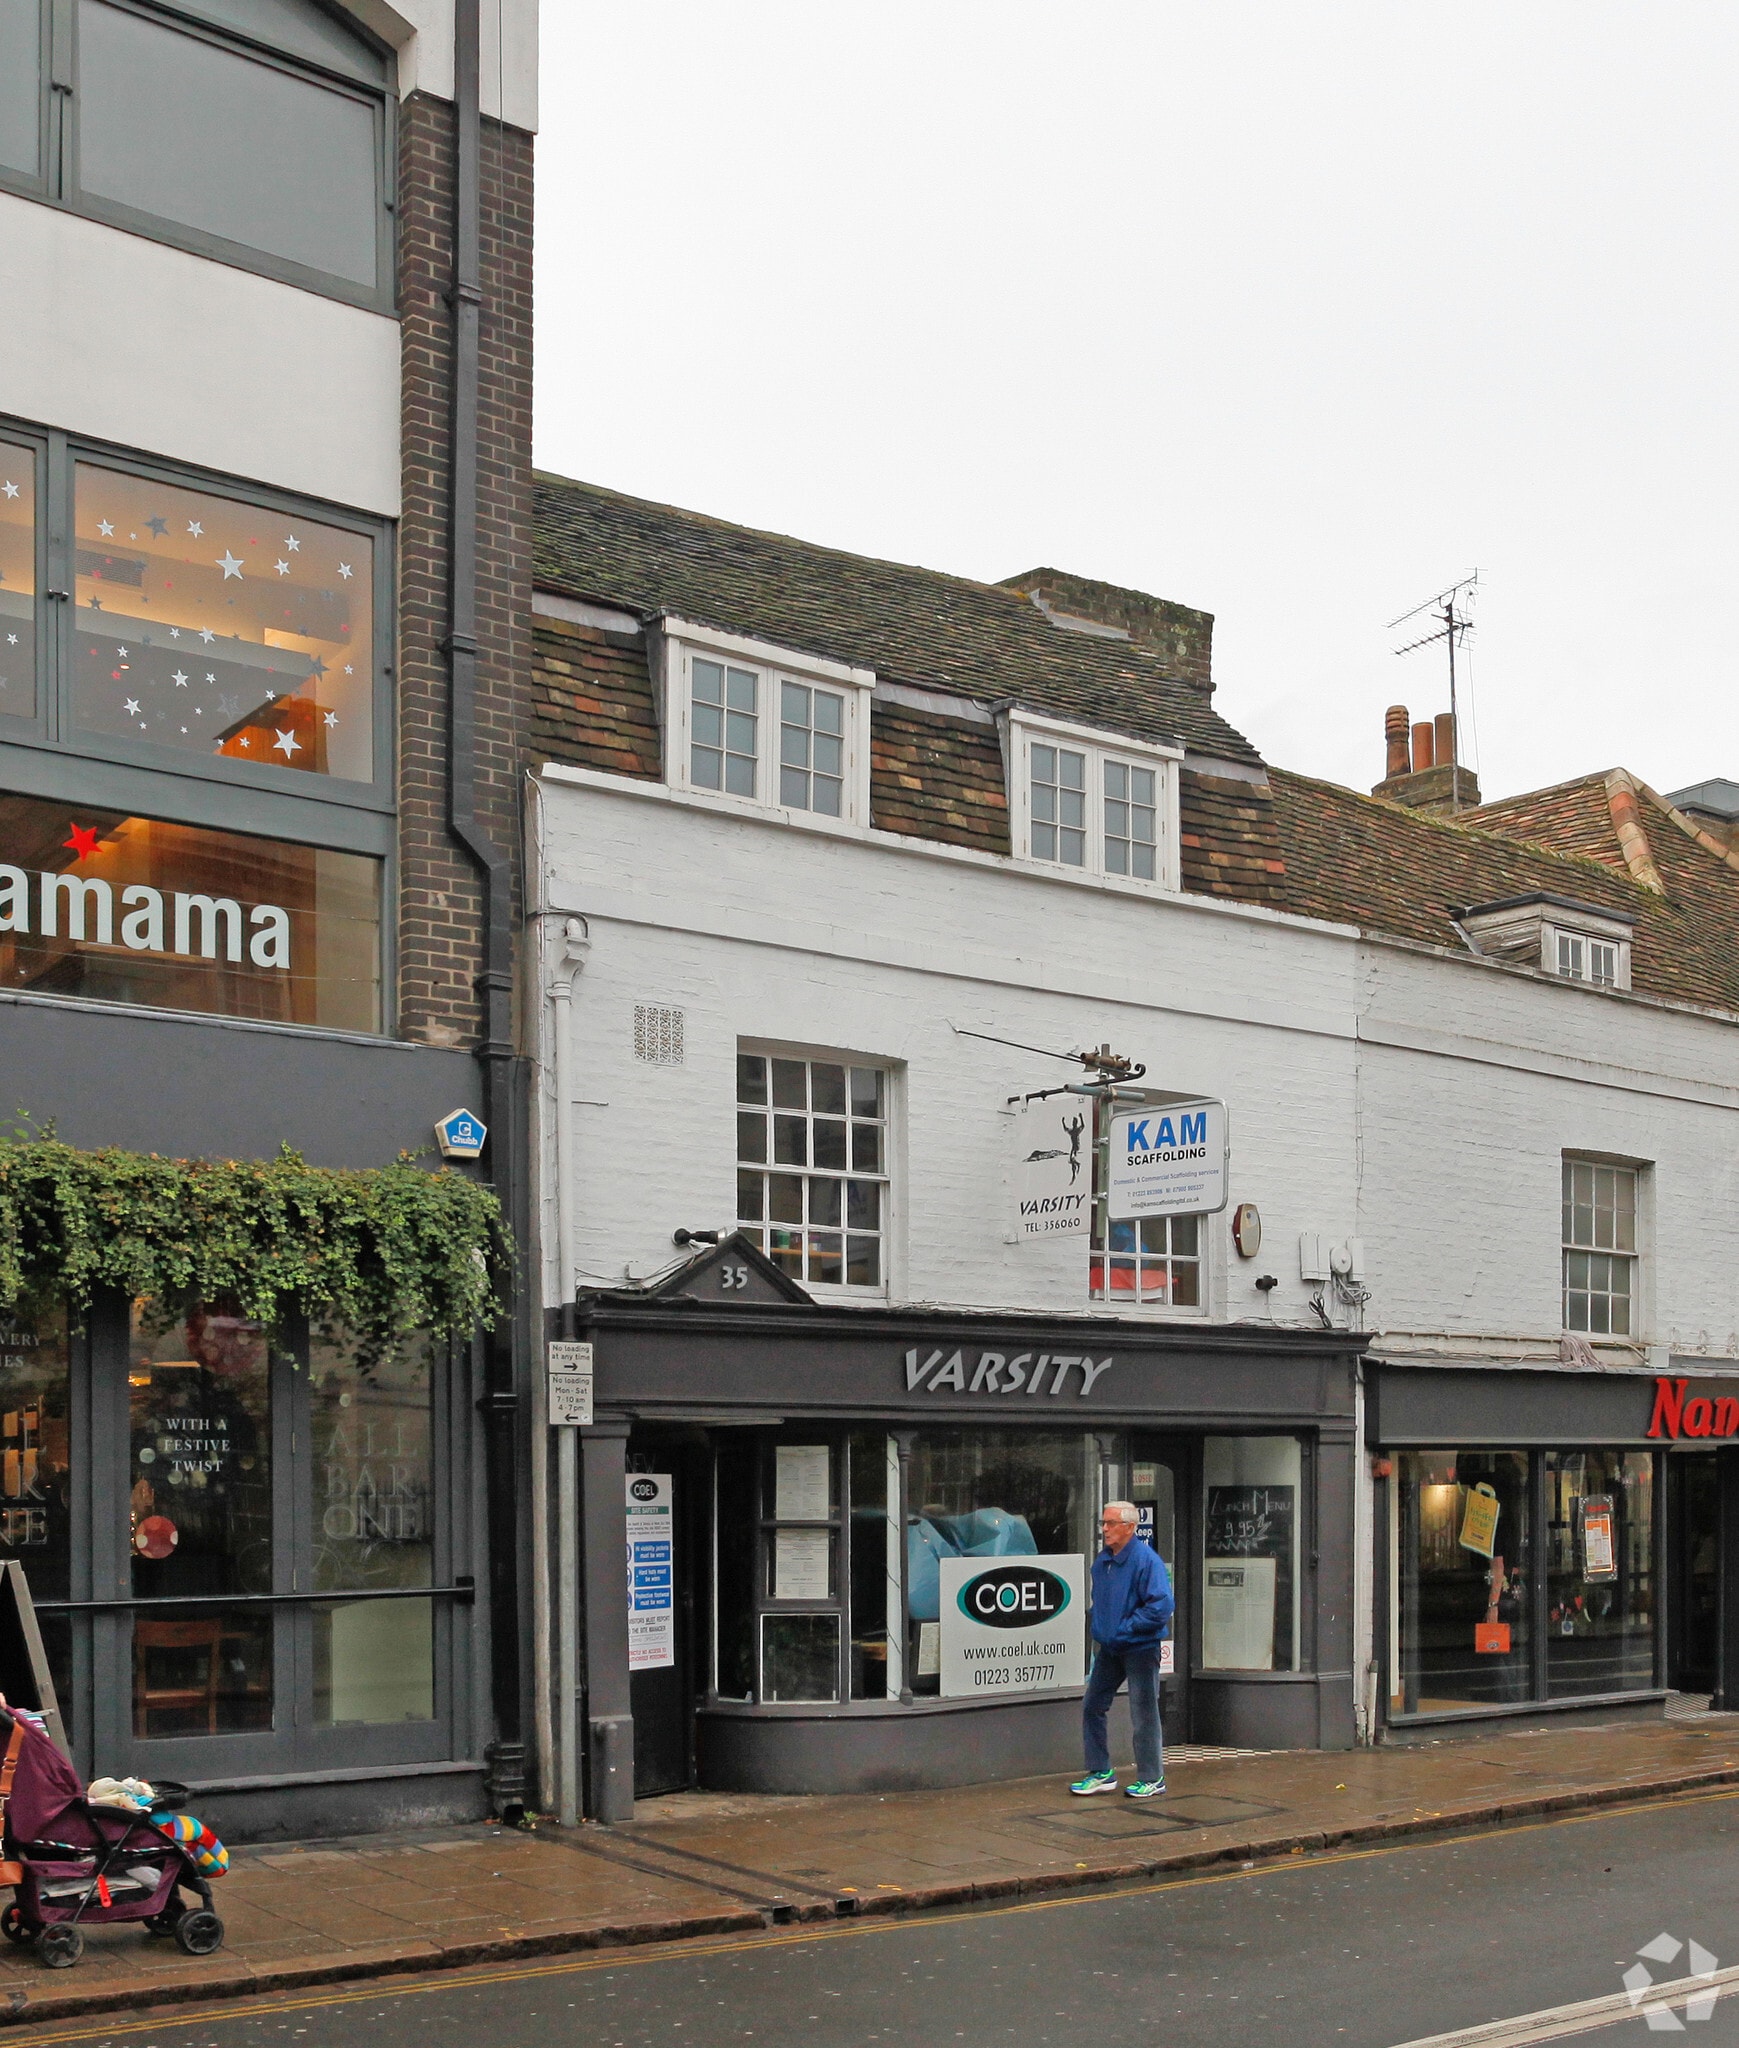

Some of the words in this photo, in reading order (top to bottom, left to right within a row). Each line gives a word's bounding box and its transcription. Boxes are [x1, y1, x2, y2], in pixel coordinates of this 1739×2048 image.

[0, 864, 290, 969] amama
[452, 1135, 478, 1145] Chubb
[1127, 1112, 1207, 1152] KAM
[1127, 1147, 1207, 1166] SCAFFOLDING
[1141, 1174, 1169, 1183] Commercial
[1170, 1171, 1197, 1179] Scaffolding
[1199, 1168, 1219, 1176] services
[1020, 1193, 1086, 1216] VARSITY
[1024, 1222, 1041, 1232] TEL:
[1044, 1217, 1081, 1231] 356060
[722, 1265, 748, 1289] 35
[564, 1345, 590, 1354] loading
[564, 1377, 590, 1385] loading
[905, 1348, 1113, 1396] VARSITY
[1647, 1377, 1739, 1440] Nan
[166, 1418, 210, 1431] WITH
[216, 1418, 228, 1431] A
[164, 1439, 231, 1452] FESTIVE
[324, 1422, 419, 1457] ALL
[172, 1459, 224, 1473] TWIST
[323, 1463, 417, 1498] BAR
[633, 1484, 656, 1496] COEL
[1253, 1490, 1291, 1515] MENU
[323, 1504, 421, 1540] ONE
[975, 1581, 1054, 1614] COEL
[963, 1640, 1066, 1660] www.coel.uk.com
[974, 1667, 1010, 1686] 01223
[1015, 1665, 1055, 1683] 357777
